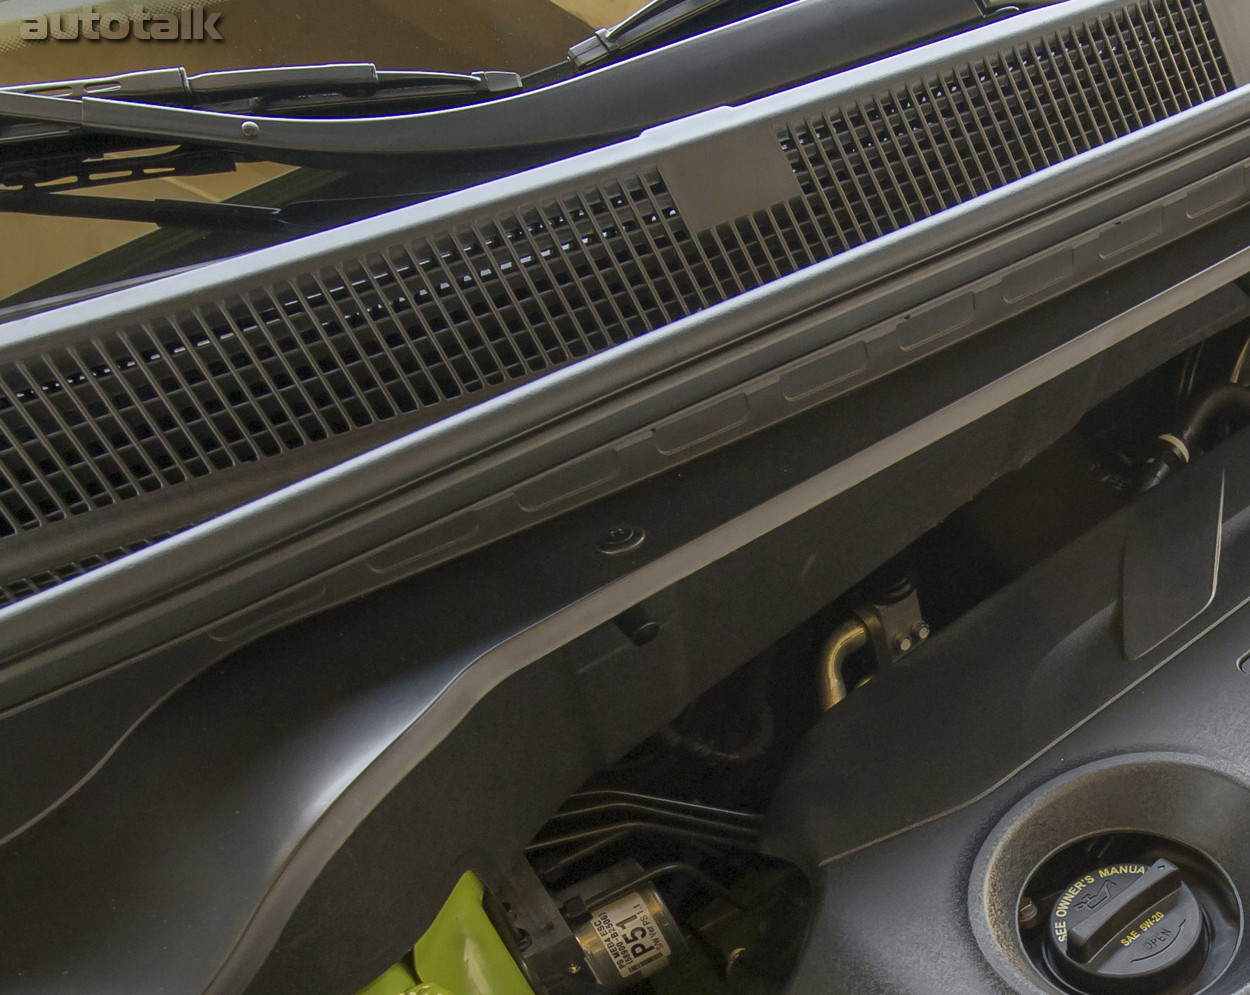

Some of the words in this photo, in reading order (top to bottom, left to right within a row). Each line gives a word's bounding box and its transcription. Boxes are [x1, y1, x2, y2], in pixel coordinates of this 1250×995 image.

[1098, 865, 1146, 878] MANUA
[1055, 874, 1095, 918] OWNER'S
[593, 920, 608, 937] ESC
[615, 913, 655, 959] P51
[1055, 920, 1068, 943] SEE
[1120, 930, 1140, 946] SAE
[1139, 911, 1165, 932] 5W-20
[1144, 928, 1171, 951] OPEN
[616, 959, 627, 970] PS
